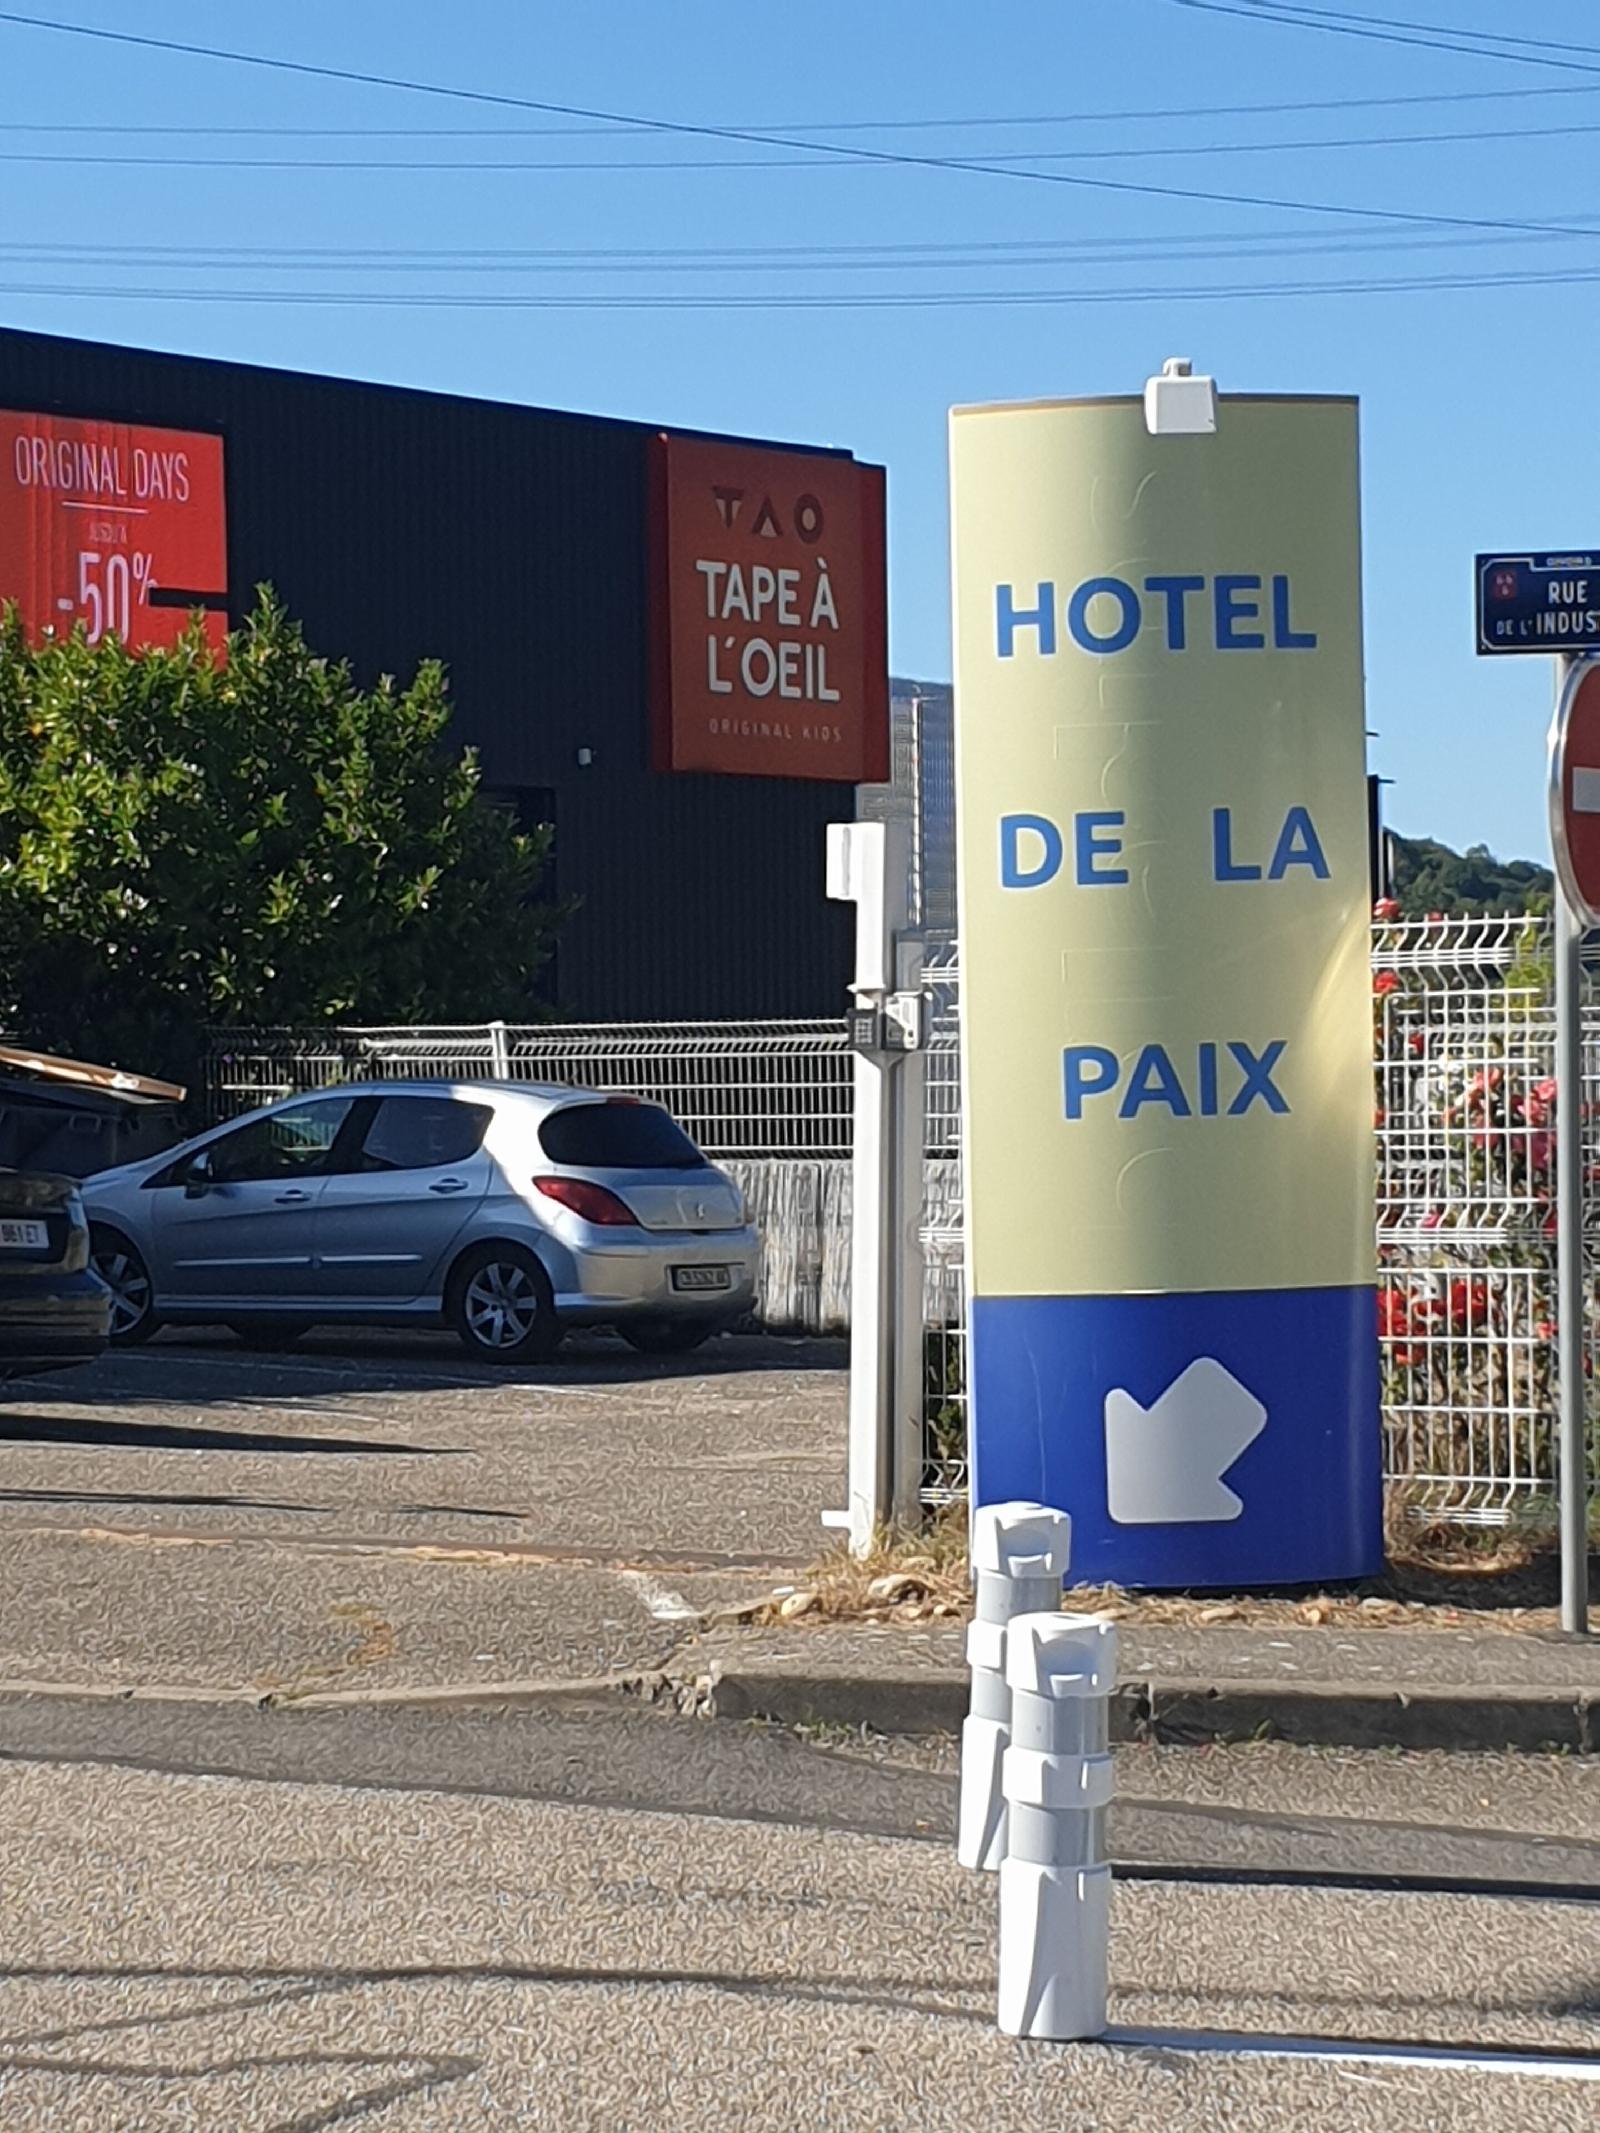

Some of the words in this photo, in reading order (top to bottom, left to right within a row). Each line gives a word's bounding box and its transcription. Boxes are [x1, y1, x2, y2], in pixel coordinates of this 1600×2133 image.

[15, 435, 128, 496] ORIGINAL
[133, 448, 190, 502] DAYS
[695, 558, 801, 625] TAPE
[810, 556, 840, 630] À
[994, 574, 1318, 659] HOTEL
[1548, 580, 1588, 604] RUE
[1496, 619, 1514, 636] DE
[707, 634, 841, 702] L'OEIL
[709, 717, 792, 740] ORIGINAL
[803, 725, 842, 743] KIDS
[999, 810, 1130, 890] DE
[1212, 805, 1332, 882] LA
[1063, 1040, 1292, 1120] PAIX
